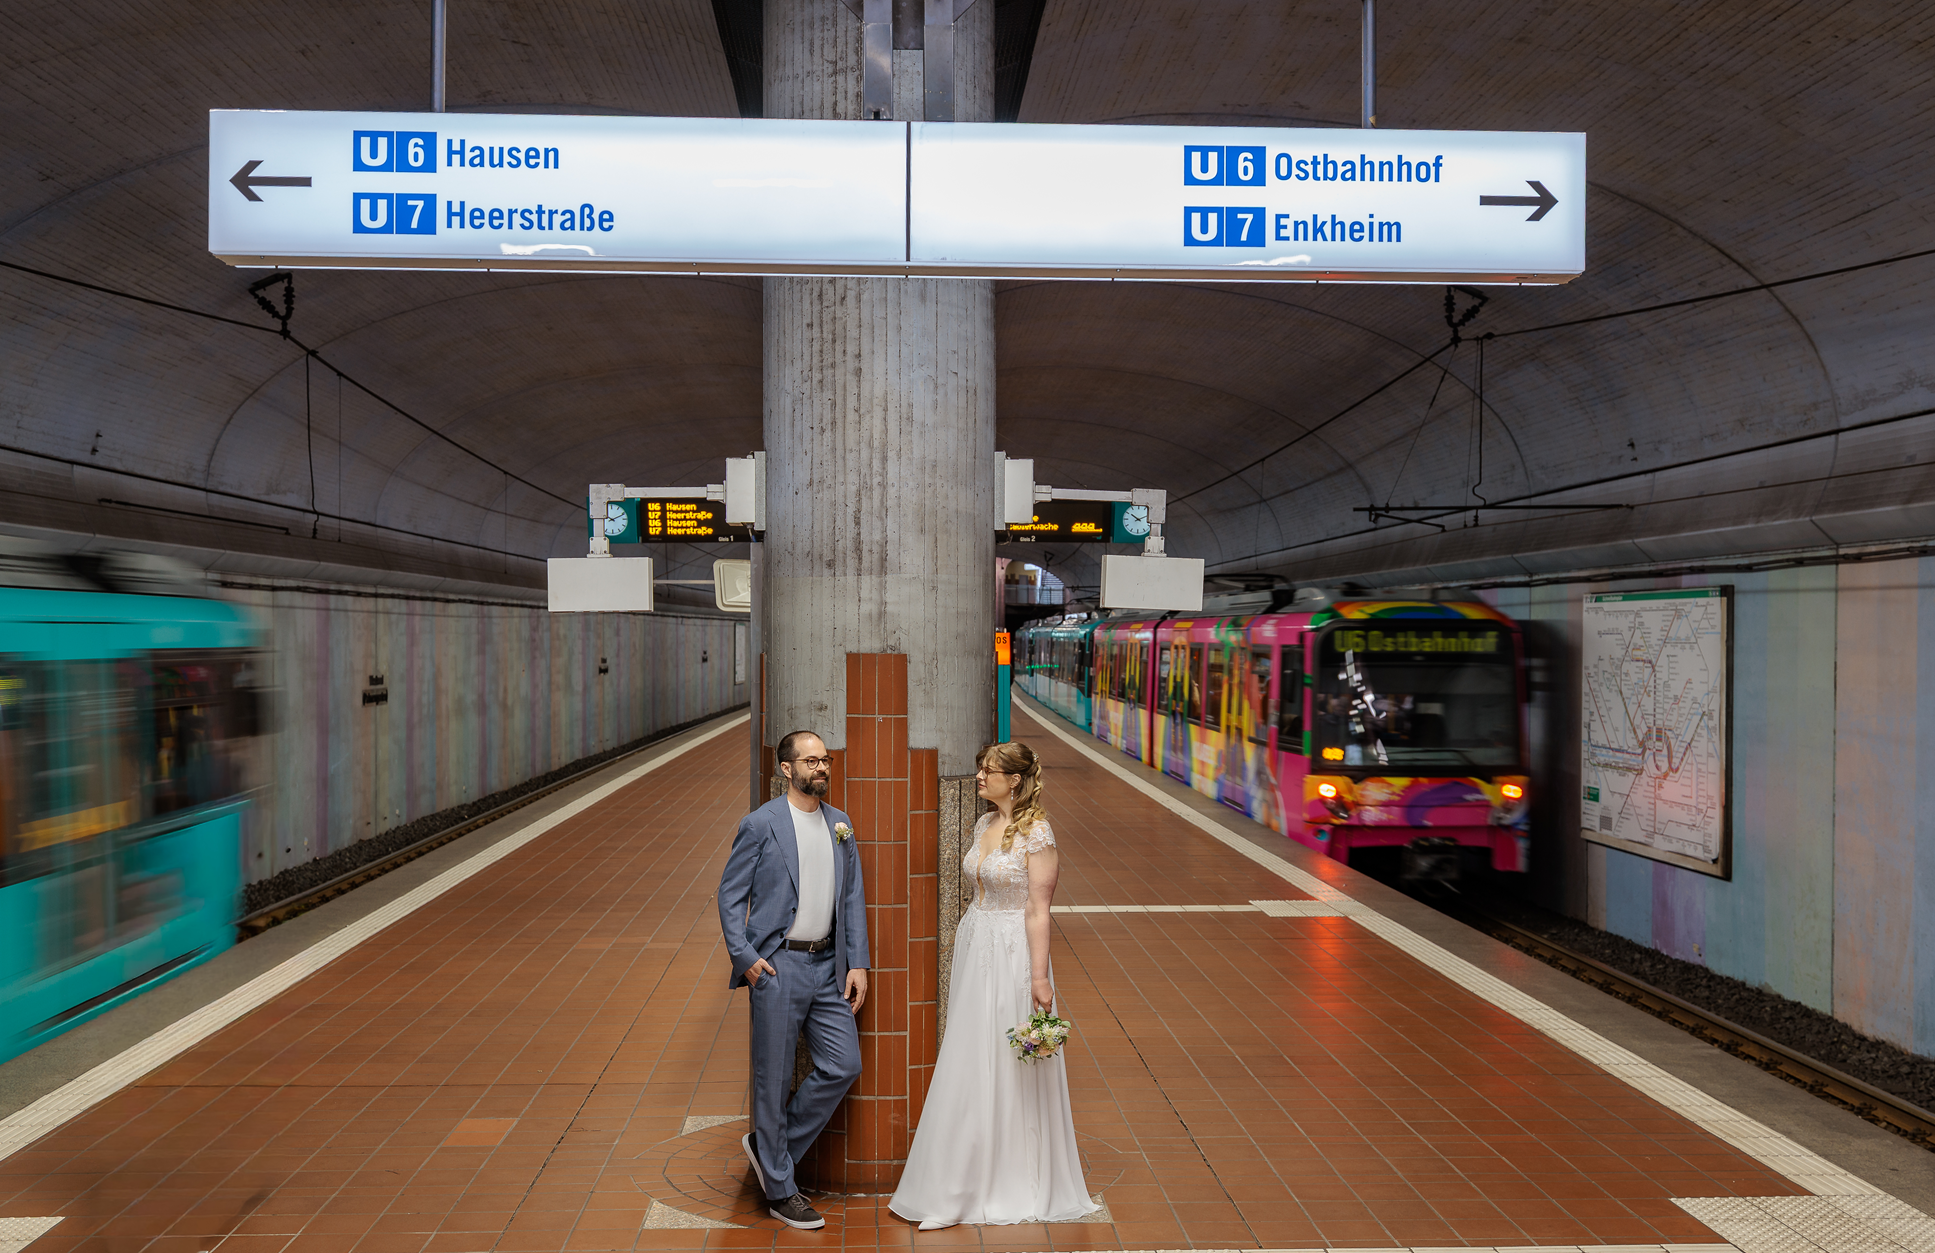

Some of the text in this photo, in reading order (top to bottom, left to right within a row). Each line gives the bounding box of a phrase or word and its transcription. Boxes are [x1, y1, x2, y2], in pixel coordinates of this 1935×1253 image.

[446, 138, 560, 170] Hausen
[1274, 152, 1444, 183] Ostbahnhof
[446, 200, 615, 233] Heerstraße
[1274, 213, 1402, 243] Enkheim
[648, 503, 697, 511] U6 Hausen
[666, 511, 713, 520] Heerstraße
[649, 527, 713, 536] U7 Heerstraße
[996, 636, 1007, 644] OS
[1334, 630, 1499, 652] U6 Ostbahnhof
